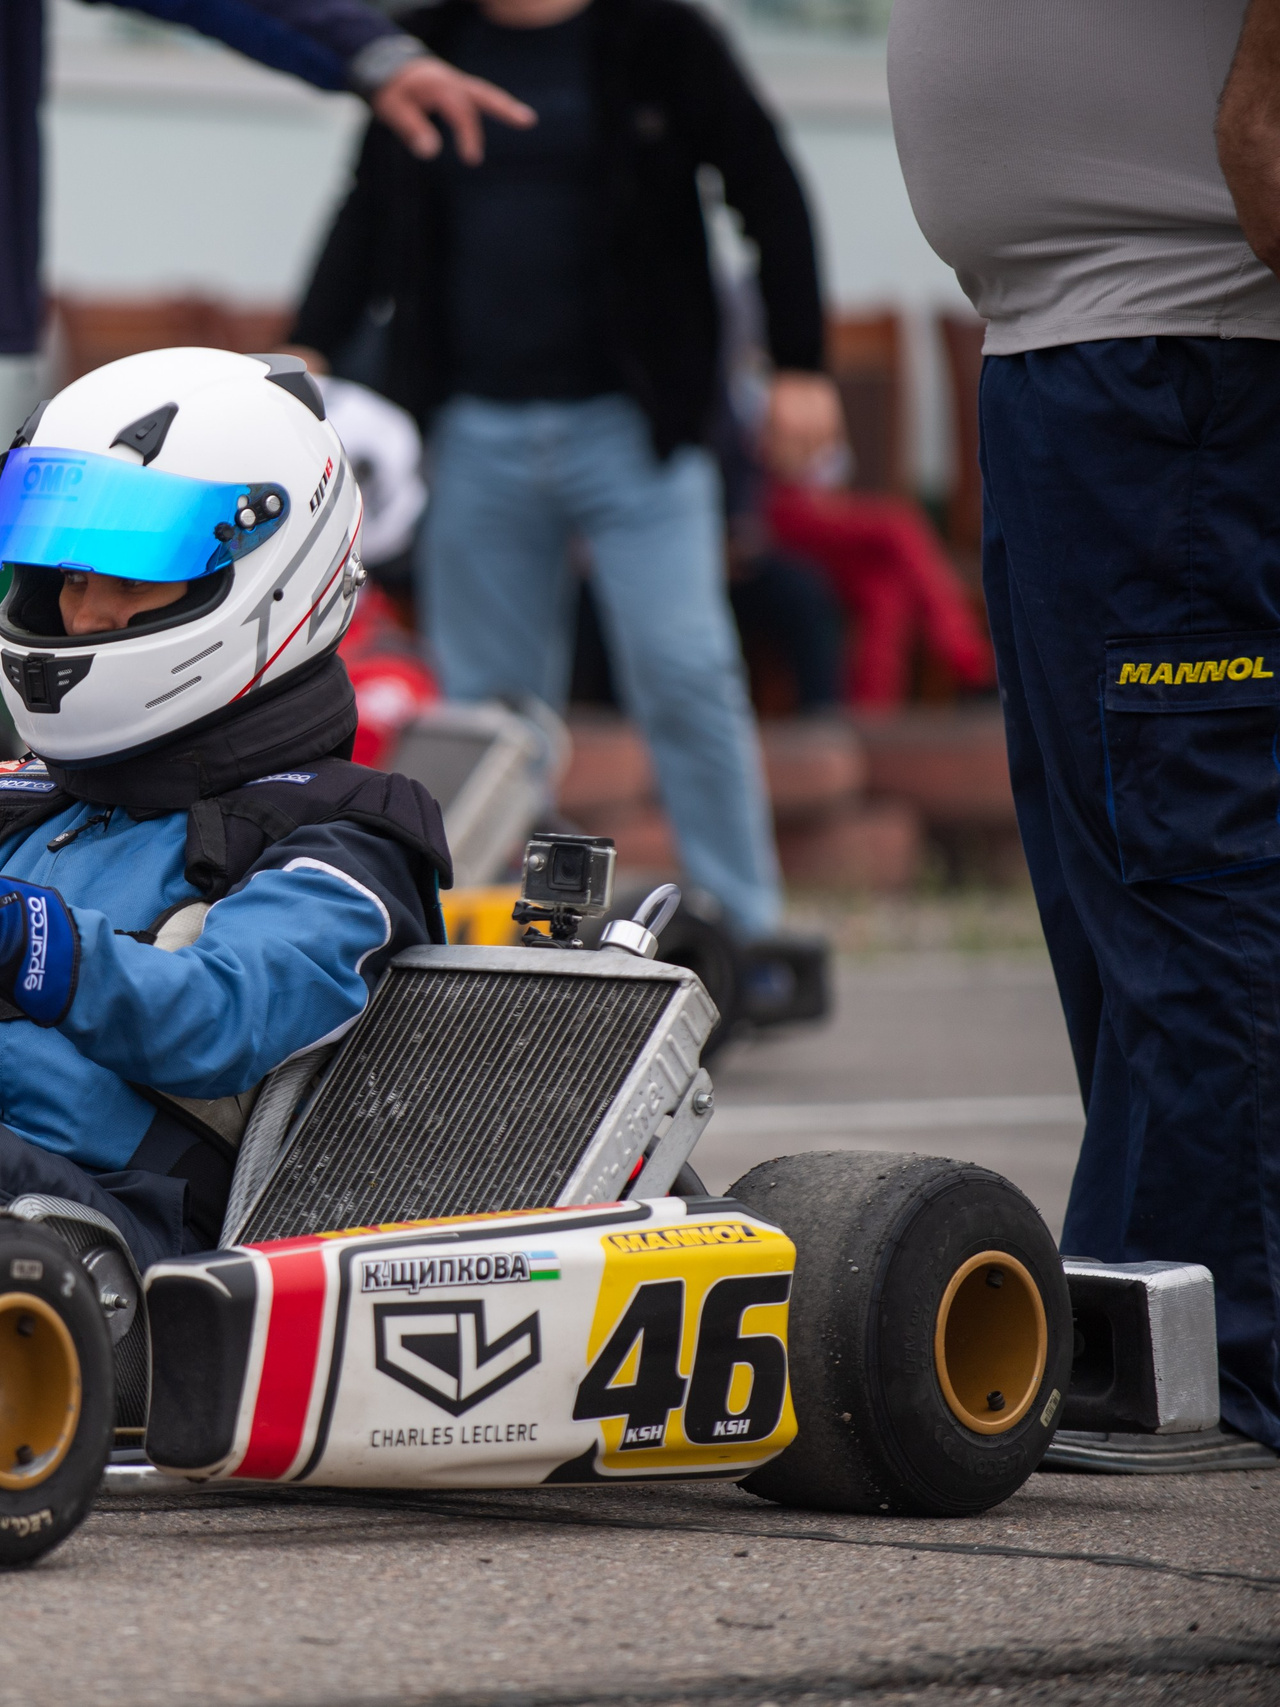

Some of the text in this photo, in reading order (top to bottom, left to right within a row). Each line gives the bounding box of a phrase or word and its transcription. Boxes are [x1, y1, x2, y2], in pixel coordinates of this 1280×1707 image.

[23, 464, 83, 492] OMP
[1116, 656, 1274, 685] MANNOL
[24, 896, 48, 991] sparco
[610, 1224, 762, 1252] MANNOL
[362, 1253, 531, 1294] К.ЩИПКОВА
[572, 1271, 793, 1451] 46
[371, 1423, 538, 1448] CHARLES LECLERC
[626, 1425, 664, 1443] KSH
[712, 1419, 751, 1436] KSH
